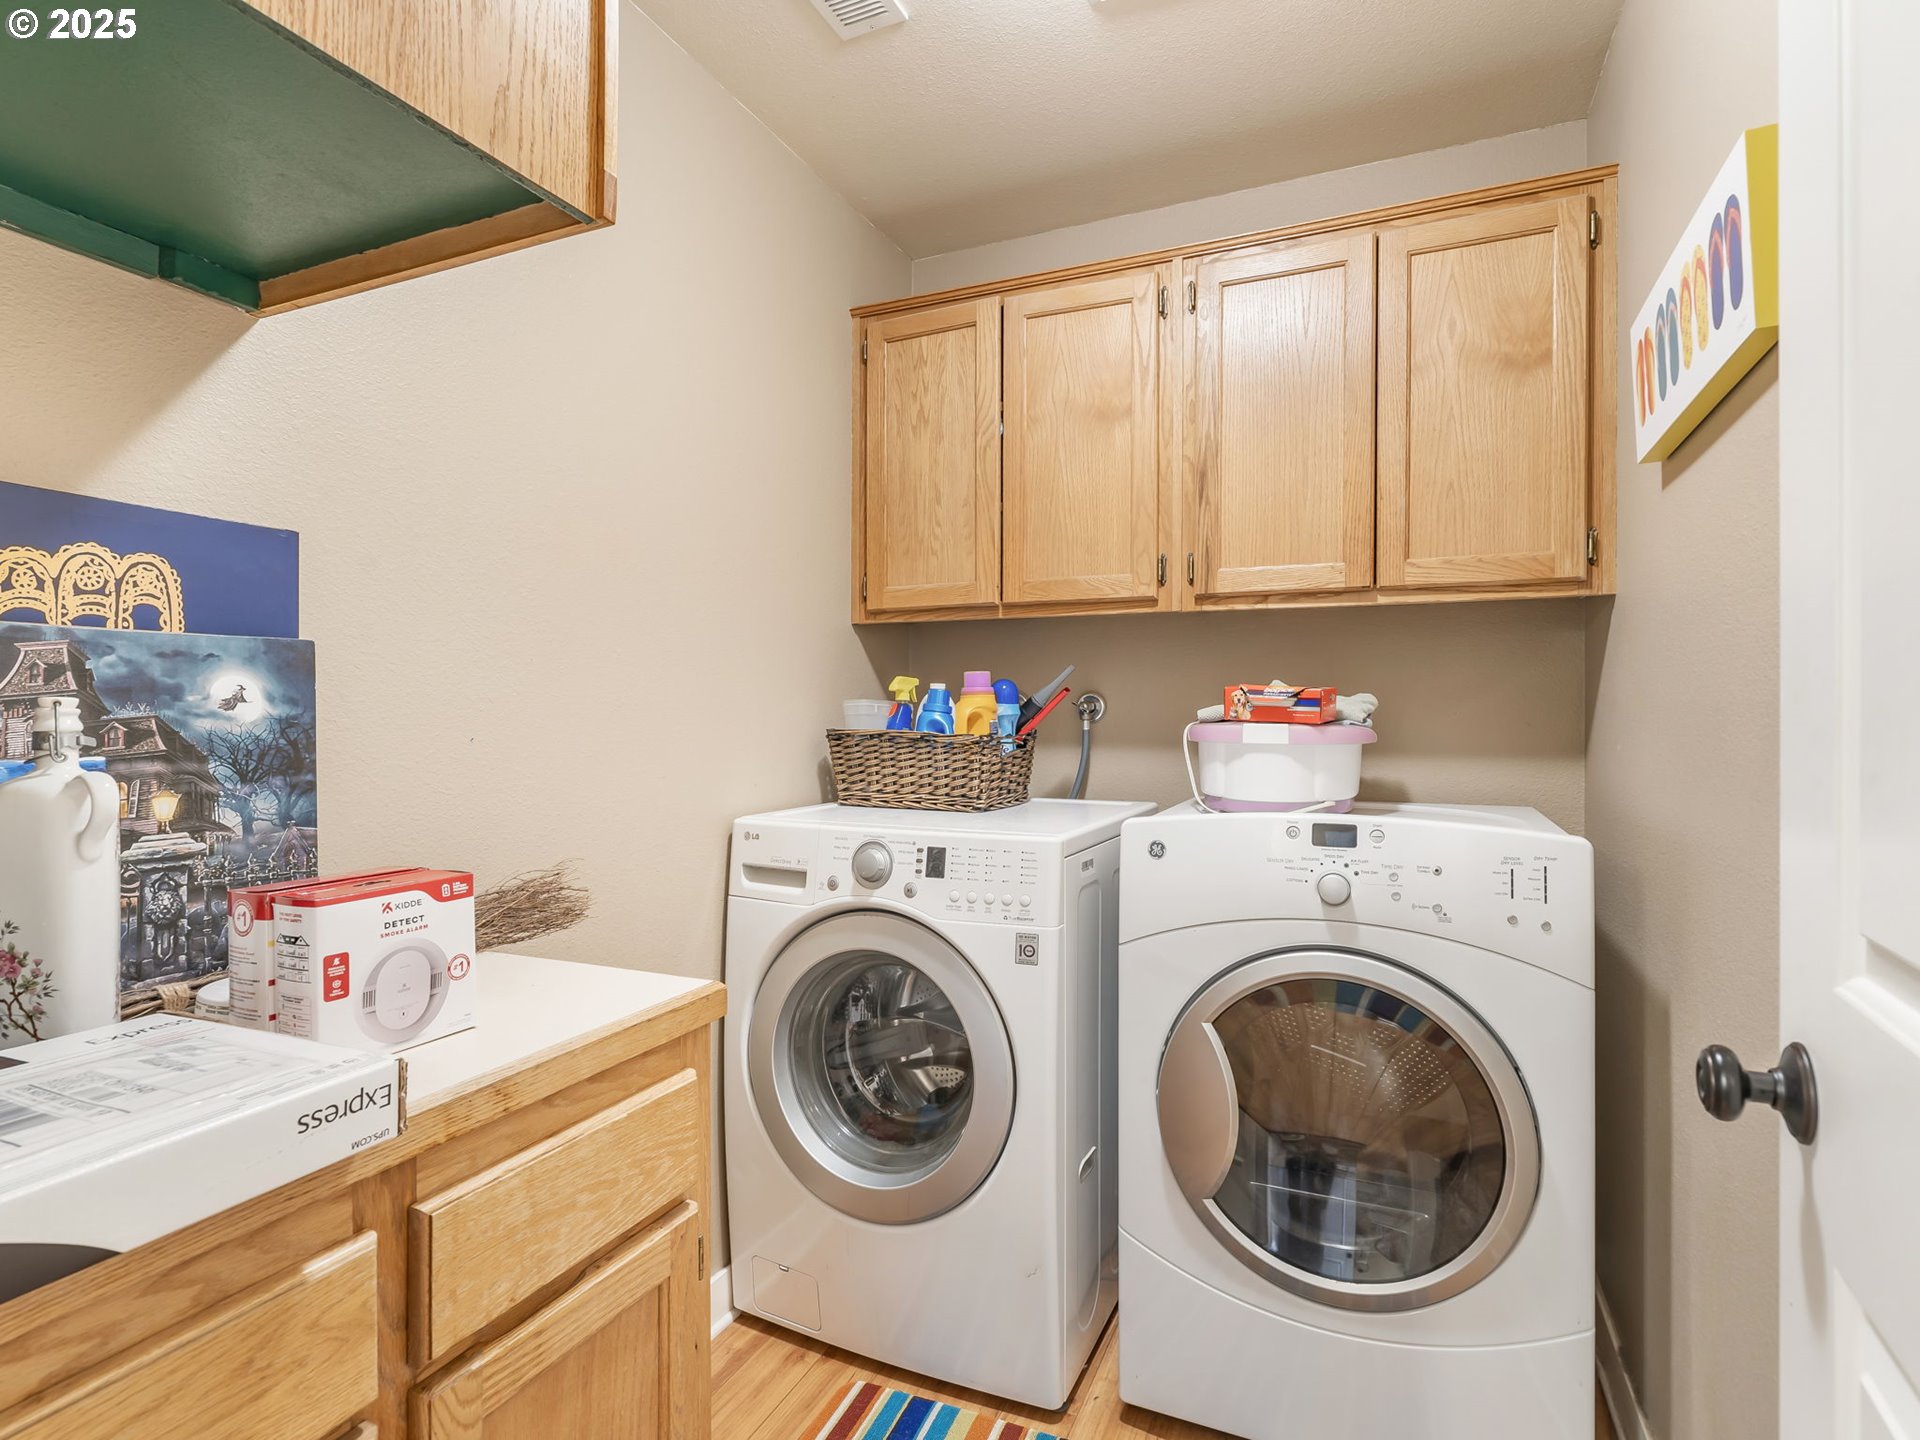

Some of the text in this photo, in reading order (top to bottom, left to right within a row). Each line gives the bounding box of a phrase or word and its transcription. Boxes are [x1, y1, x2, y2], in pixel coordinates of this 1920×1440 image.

[394, 899, 423, 910] KIDDE
[384, 914, 425, 929] DETECT
[380, 924, 429, 939] SMOKE ALARM
[297, 1083, 392, 1135] Express
[351, 1128, 390, 1150] UPS.COM
